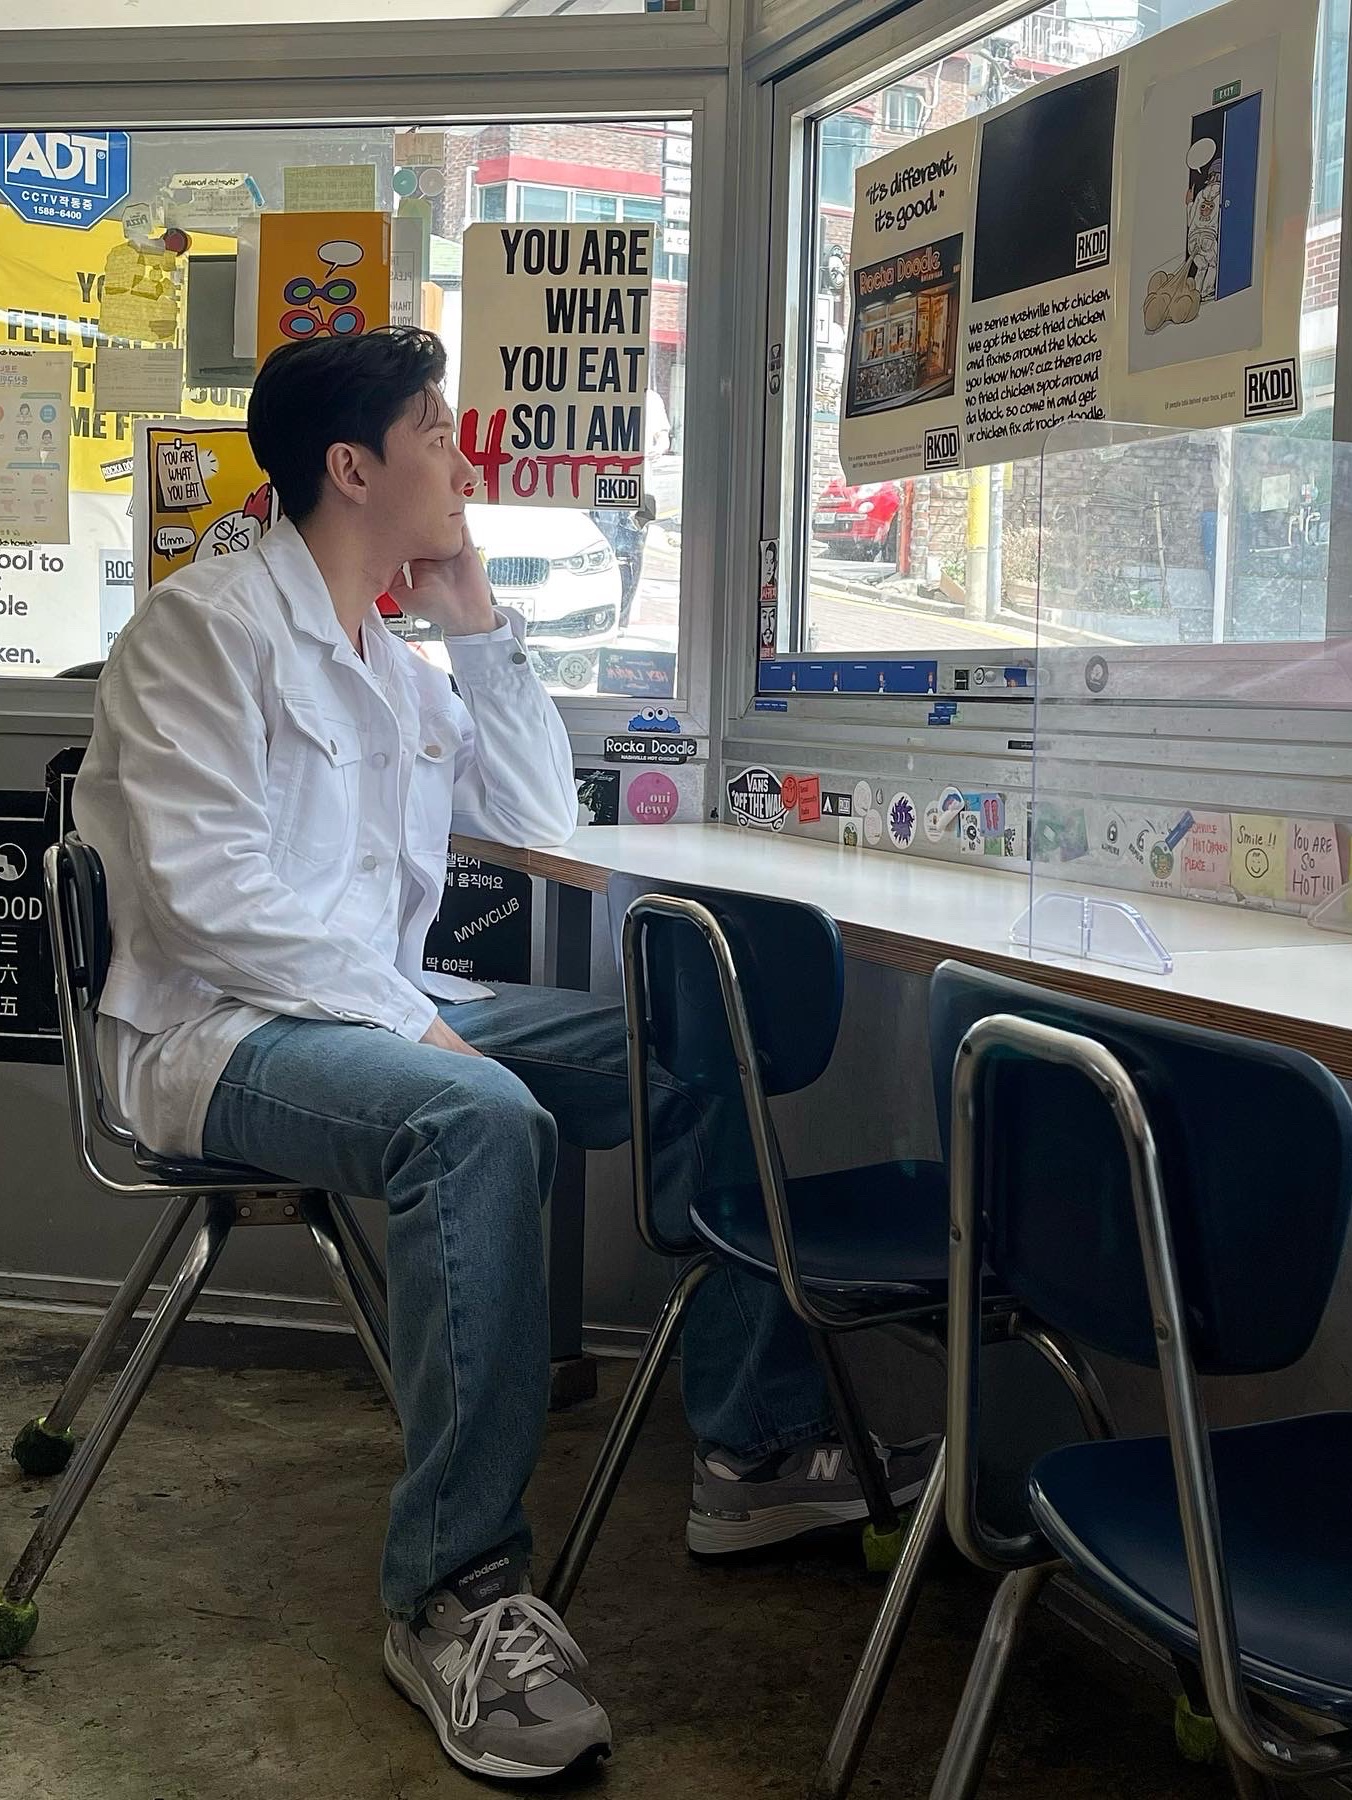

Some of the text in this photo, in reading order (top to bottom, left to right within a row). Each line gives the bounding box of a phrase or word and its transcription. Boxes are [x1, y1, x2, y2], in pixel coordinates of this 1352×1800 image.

[7, 133, 108, 185] ADT
[891, 151, 957, 197] different,
[33, 206, 82, 219] 1588-6400
[875, 210, 894, 232] it's
[501, 229, 649, 275] YOU ARE
[1078, 230, 1107, 260] RKDD
[859, 246, 940, 295] Rocka Doodle
[546, 288, 648, 334] WHAT
[984, 315, 1008, 331] serve
[1010, 303, 1050, 324] nashville
[1052, 296, 1070, 313] hot
[1071, 289, 1110, 307] chicken
[983, 335, 1000, 352] got
[1001, 330, 1016, 344] the
[1018, 323, 1040, 341] best
[1043, 316, 1065, 335] fried
[1067, 309, 1106, 328] chicken
[967, 357, 984, 371] and
[1013, 342, 1046, 359] around
[1048, 337, 1064, 349] the
[1067, 329, 1097, 347] block
[500, 346, 644, 392] YOU EAT
[966, 376, 982, 392] you
[984, 369, 1008, 385] know
[1010, 362, 1034, 379] how?
[1054, 355, 1081, 369] there
[1083, 349, 1102, 363] are
[965, 366, 1098, 407] no fried chicken spot around
[1248, 368, 1292, 403] RKDD
[966, 386, 1097, 425] da block so come in and get
[512, 404, 641, 451] SO I AM
[967, 430, 975, 442] ur
[977, 425, 1008, 441] chicken
[1009, 422, 1021, 434] fix
[1023, 416, 1035, 431] at
[162, 450, 195, 465] YOU ARE
[927, 432, 957, 460] RKDD
[168, 467, 192, 482] WHAT
[598, 478, 638, 500] RKDD
[167, 481, 201, 501] YOU EAT
[40, 553, 64, 573] to
[606, 739, 695, 754] Rocka Doodle
[650, 792, 670, 803] oui
[747, 774, 768, 792] VANS
[637, 802, 669, 817] dewy
[749, 794, 764, 818] THE
[1237, 825, 1263, 845] Smile
[1312, 837, 1332, 853] ARE
[457, 872, 503, 889] 움직여요
[1293, 869, 1320, 898] HOT
[454, 898, 520, 942] MVVVCLUB
[426, 957, 473, 973] 딱 60분!
[806, 1449, 842, 1481] N
[459, 1557, 510, 1587] new balance
